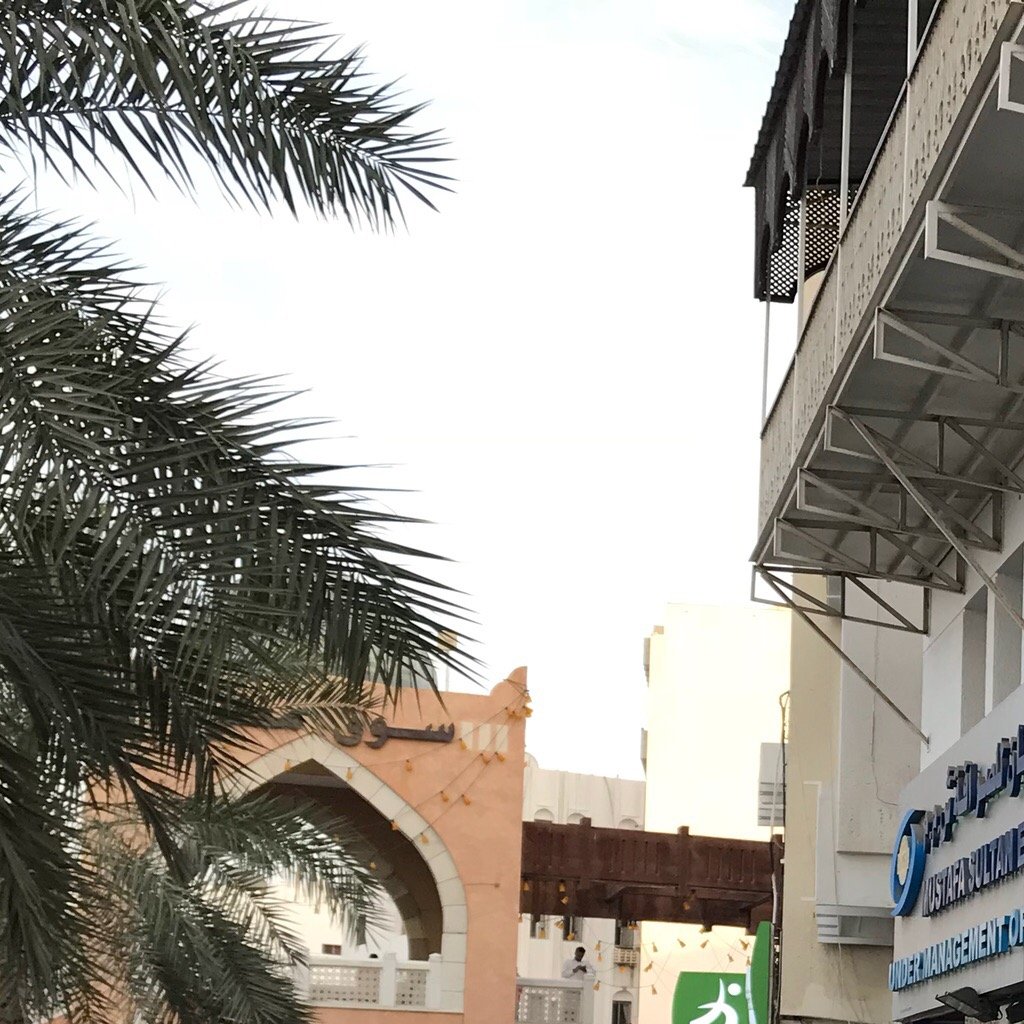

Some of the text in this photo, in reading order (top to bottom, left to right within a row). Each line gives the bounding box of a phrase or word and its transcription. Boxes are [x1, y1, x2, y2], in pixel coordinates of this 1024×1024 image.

[921, 856, 970, 918] MUSTAFA
[968, 826, 1019, 894] SULTAN
[888, 955, 925, 992] UNDER
[922, 914, 1012, 980] MANAGEMENT
